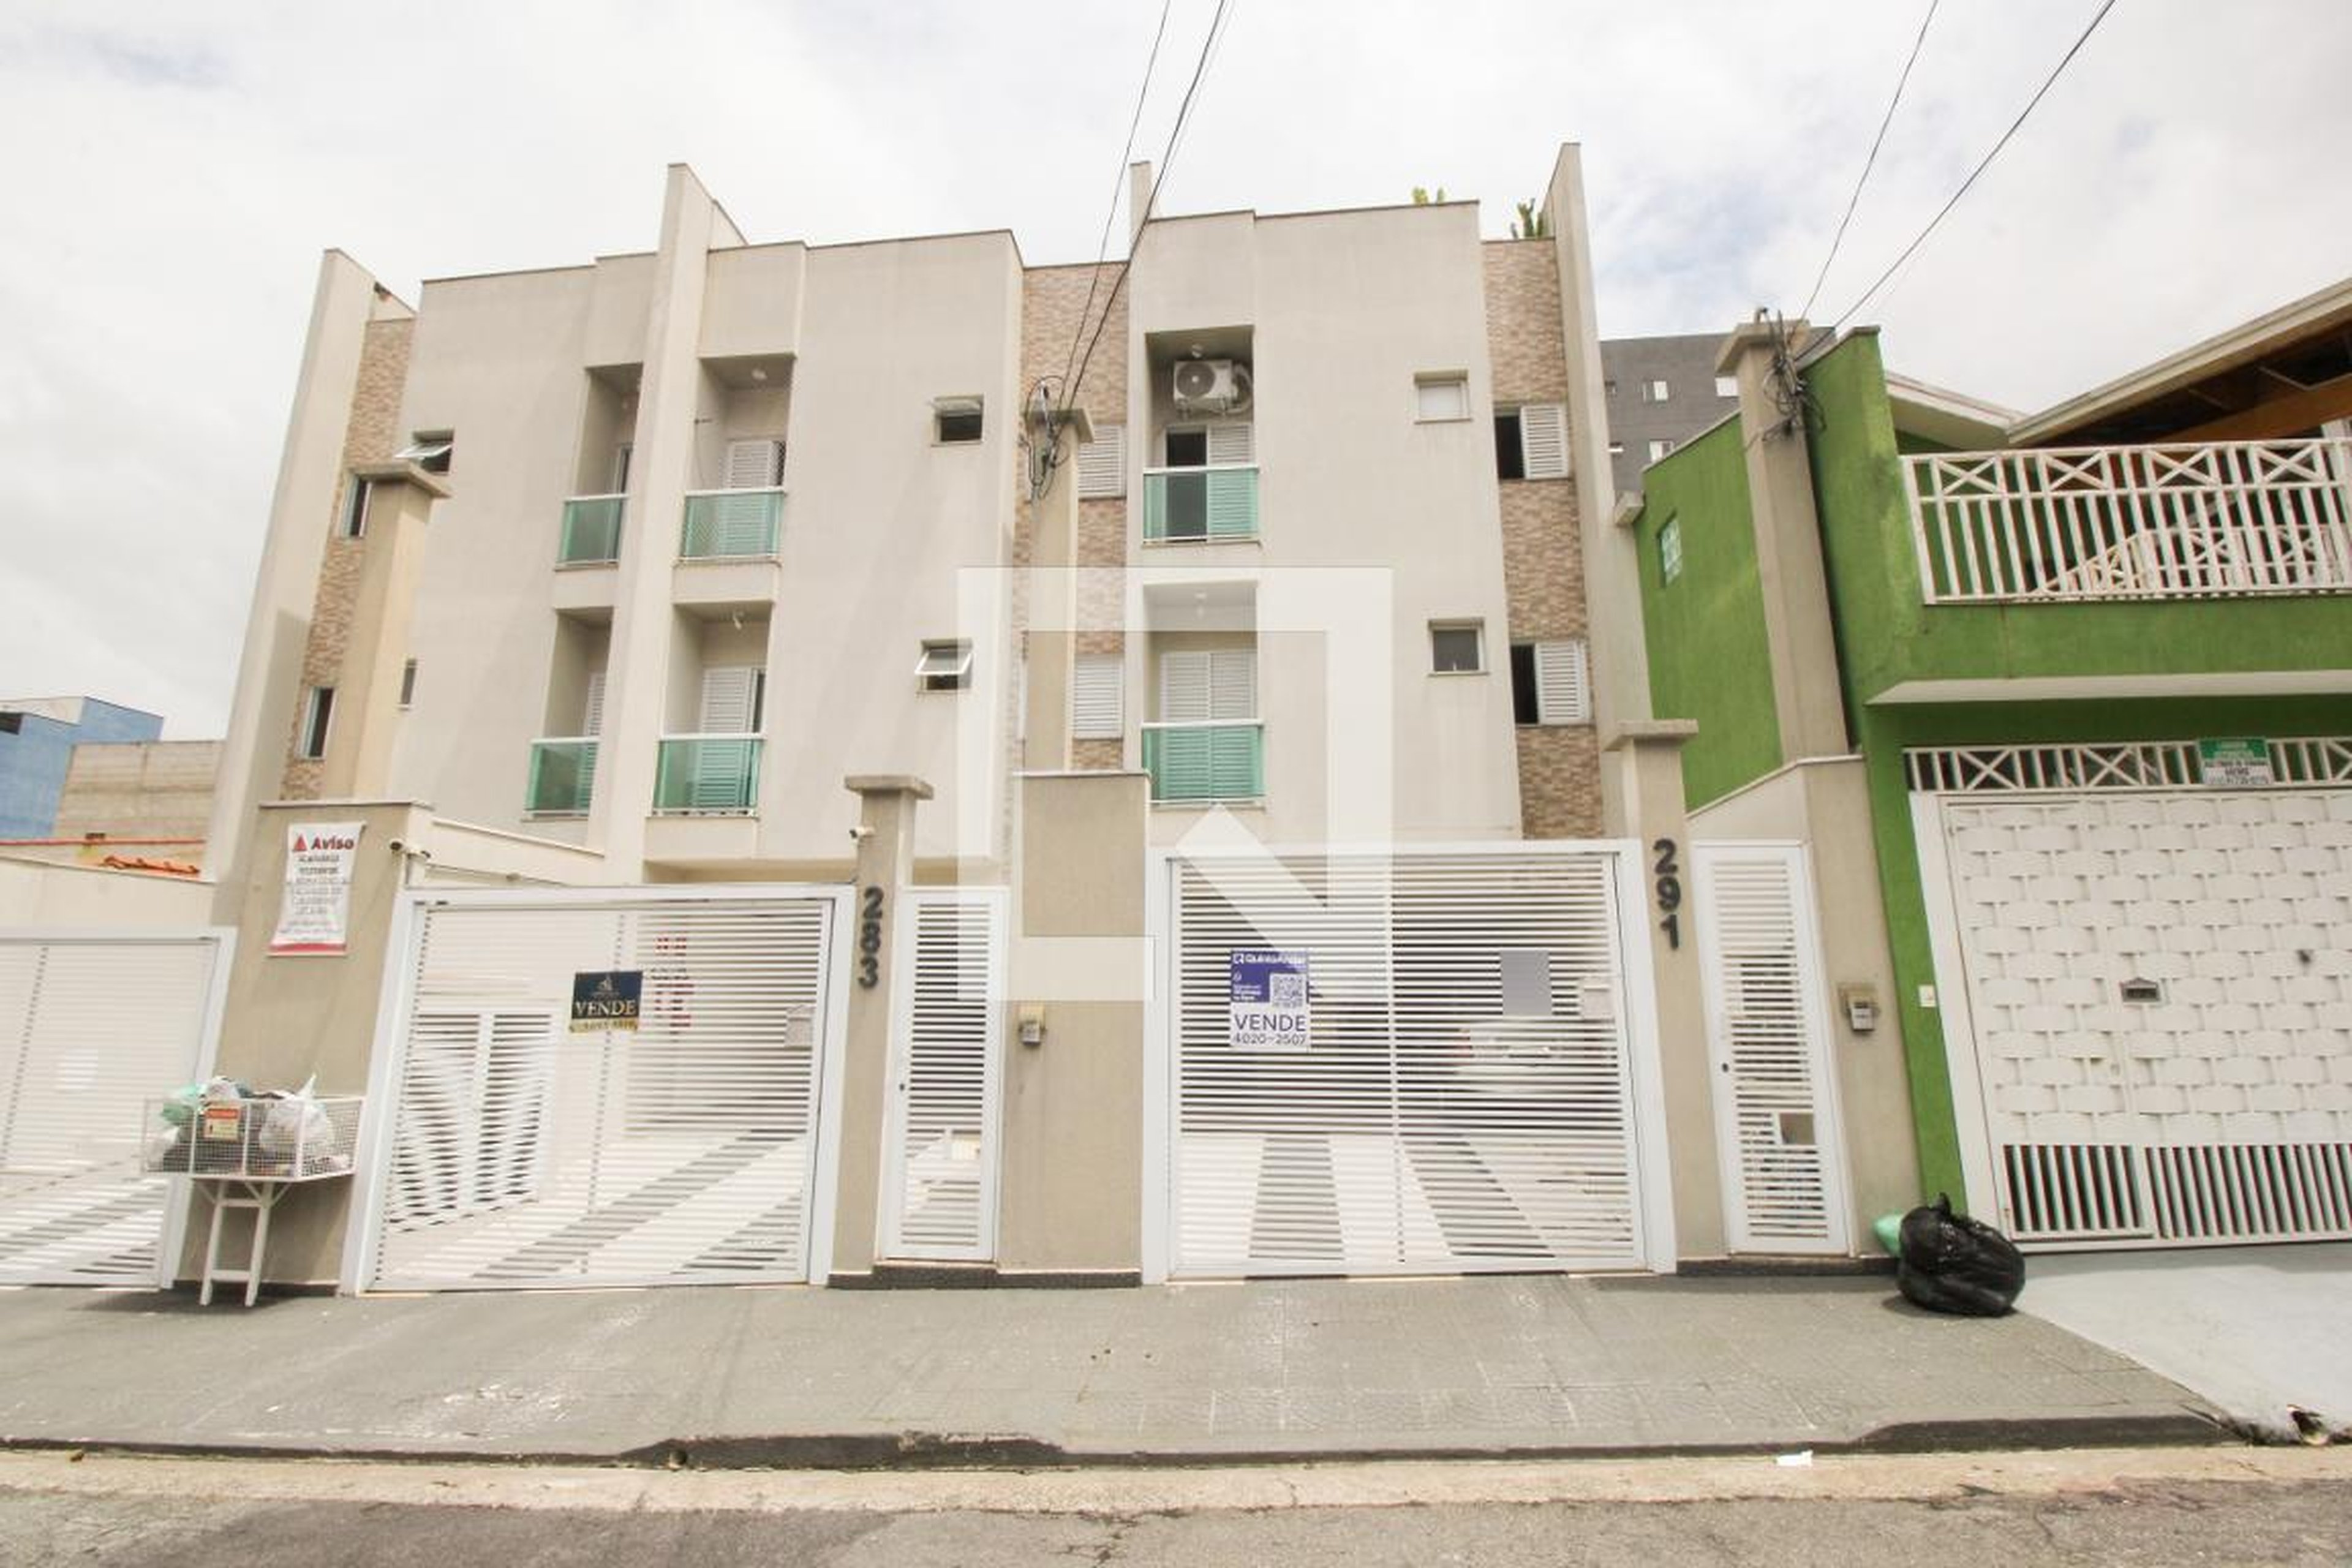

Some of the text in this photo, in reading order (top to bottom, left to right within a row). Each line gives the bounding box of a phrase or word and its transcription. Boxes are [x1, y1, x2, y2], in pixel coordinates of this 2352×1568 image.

[311, 835, 355, 850] Aviso
[1654, 839, 1681, 950] 291
[858, 887, 884, 990] 283
[575, 999, 636, 1016] VENDE
[1234, 1014, 1306, 1032] VENDE
[1233, 1032, 1306, 1046] 4020-2507
